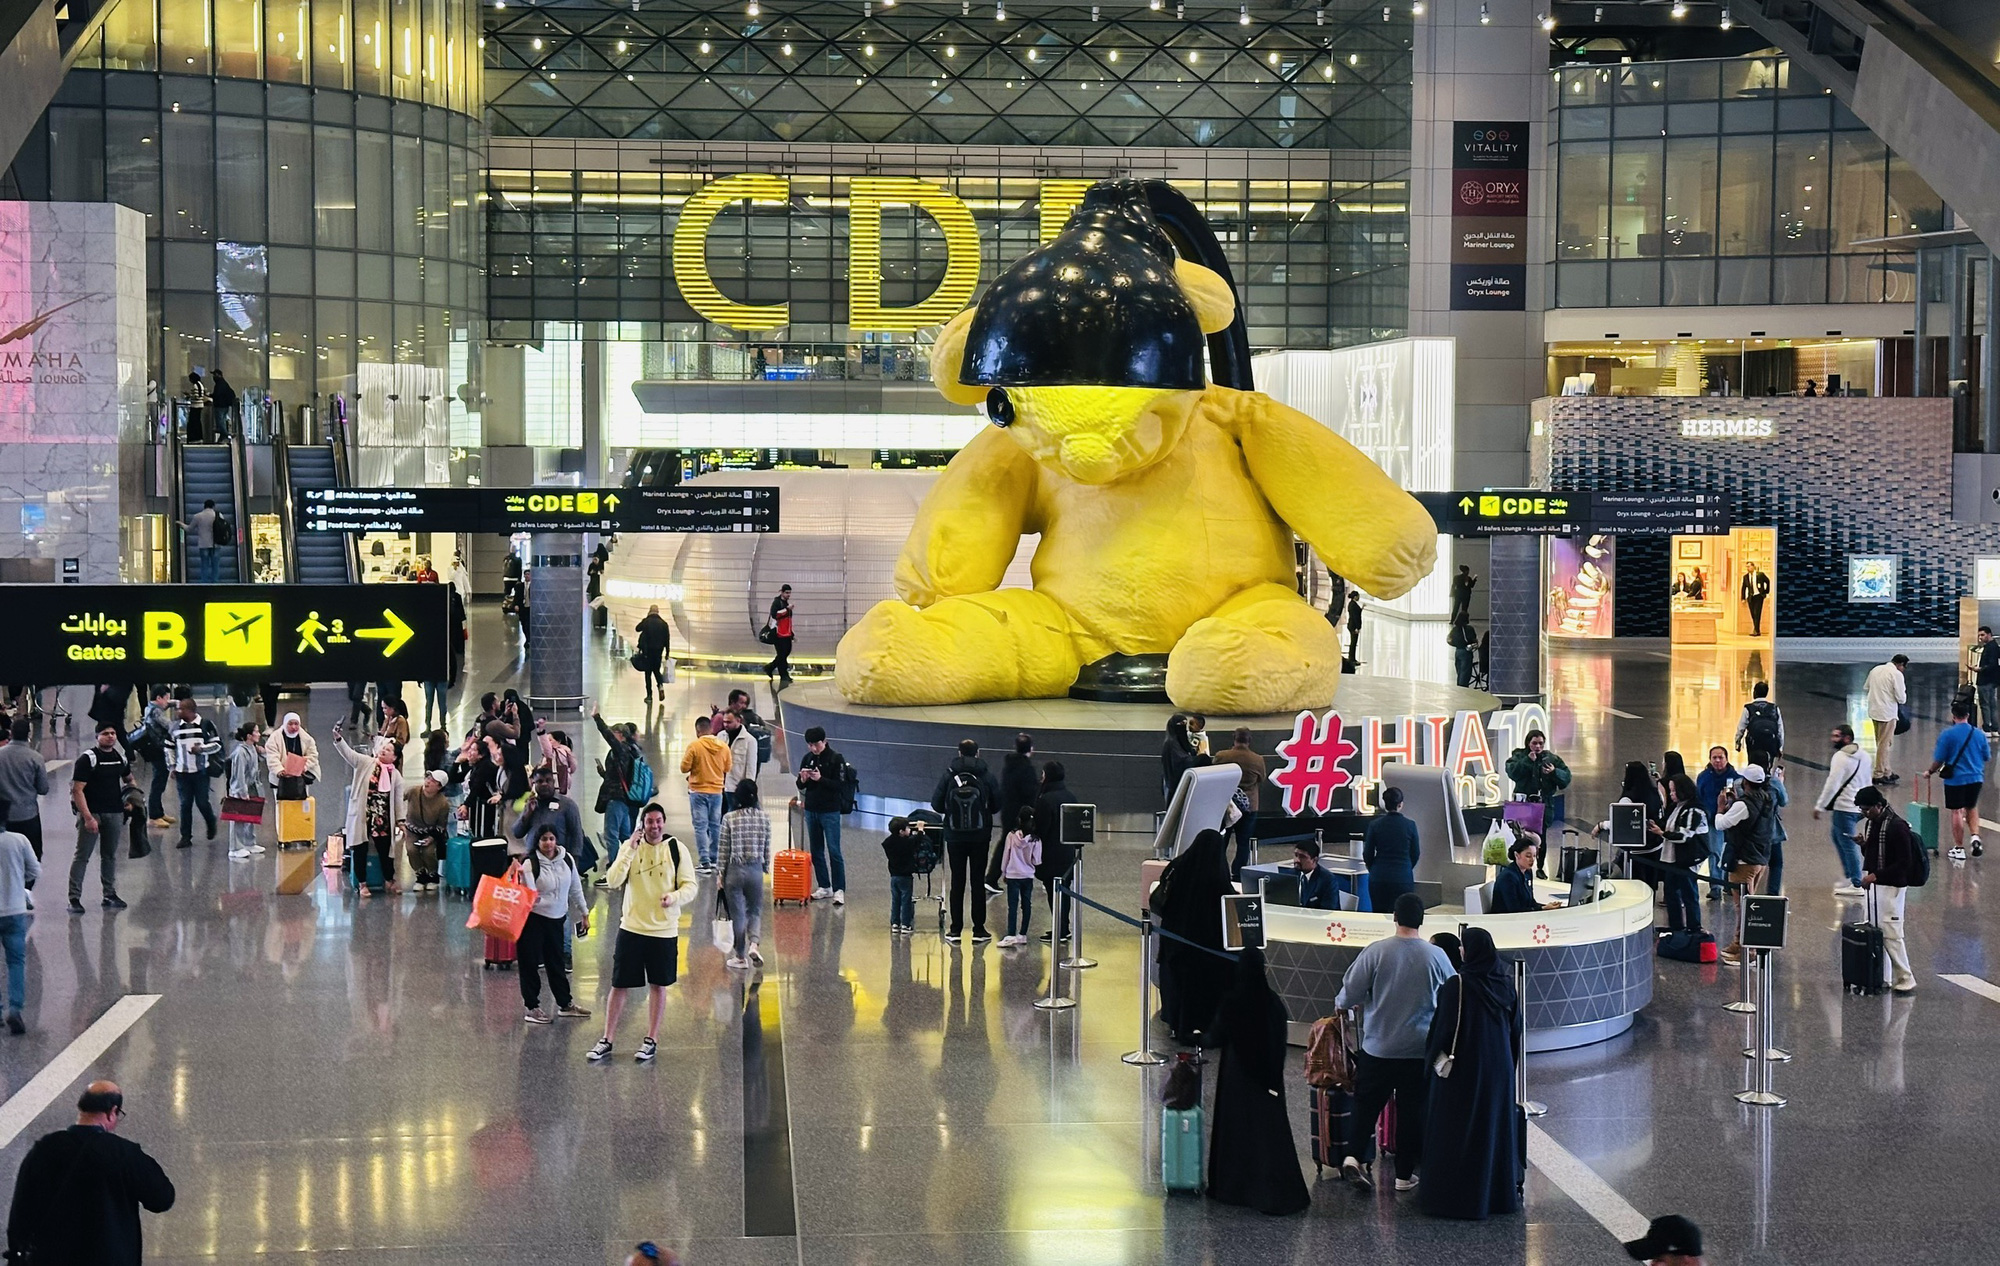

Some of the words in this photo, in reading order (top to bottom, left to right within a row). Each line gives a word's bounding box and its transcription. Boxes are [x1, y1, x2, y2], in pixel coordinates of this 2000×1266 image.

[1464, 144, 1518, 152] VITALITY
[1486, 182, 1519, 194] ORYX
[4, 352, 83, 368] MAHA
[40, 374, 87, 384] LOUNGE
[528, 495, 574, 512] CDE
[1502, 498, 1546, 515] CDE
[61, 612, 126, 636] بوابات
[332, 618, 344, 633] 3
[144, 611, 187, 660] B
[327, 634, 351, 643] min.
[68, 644, 126, 660] Gates
[1350, 772, 1500, 815] tns
